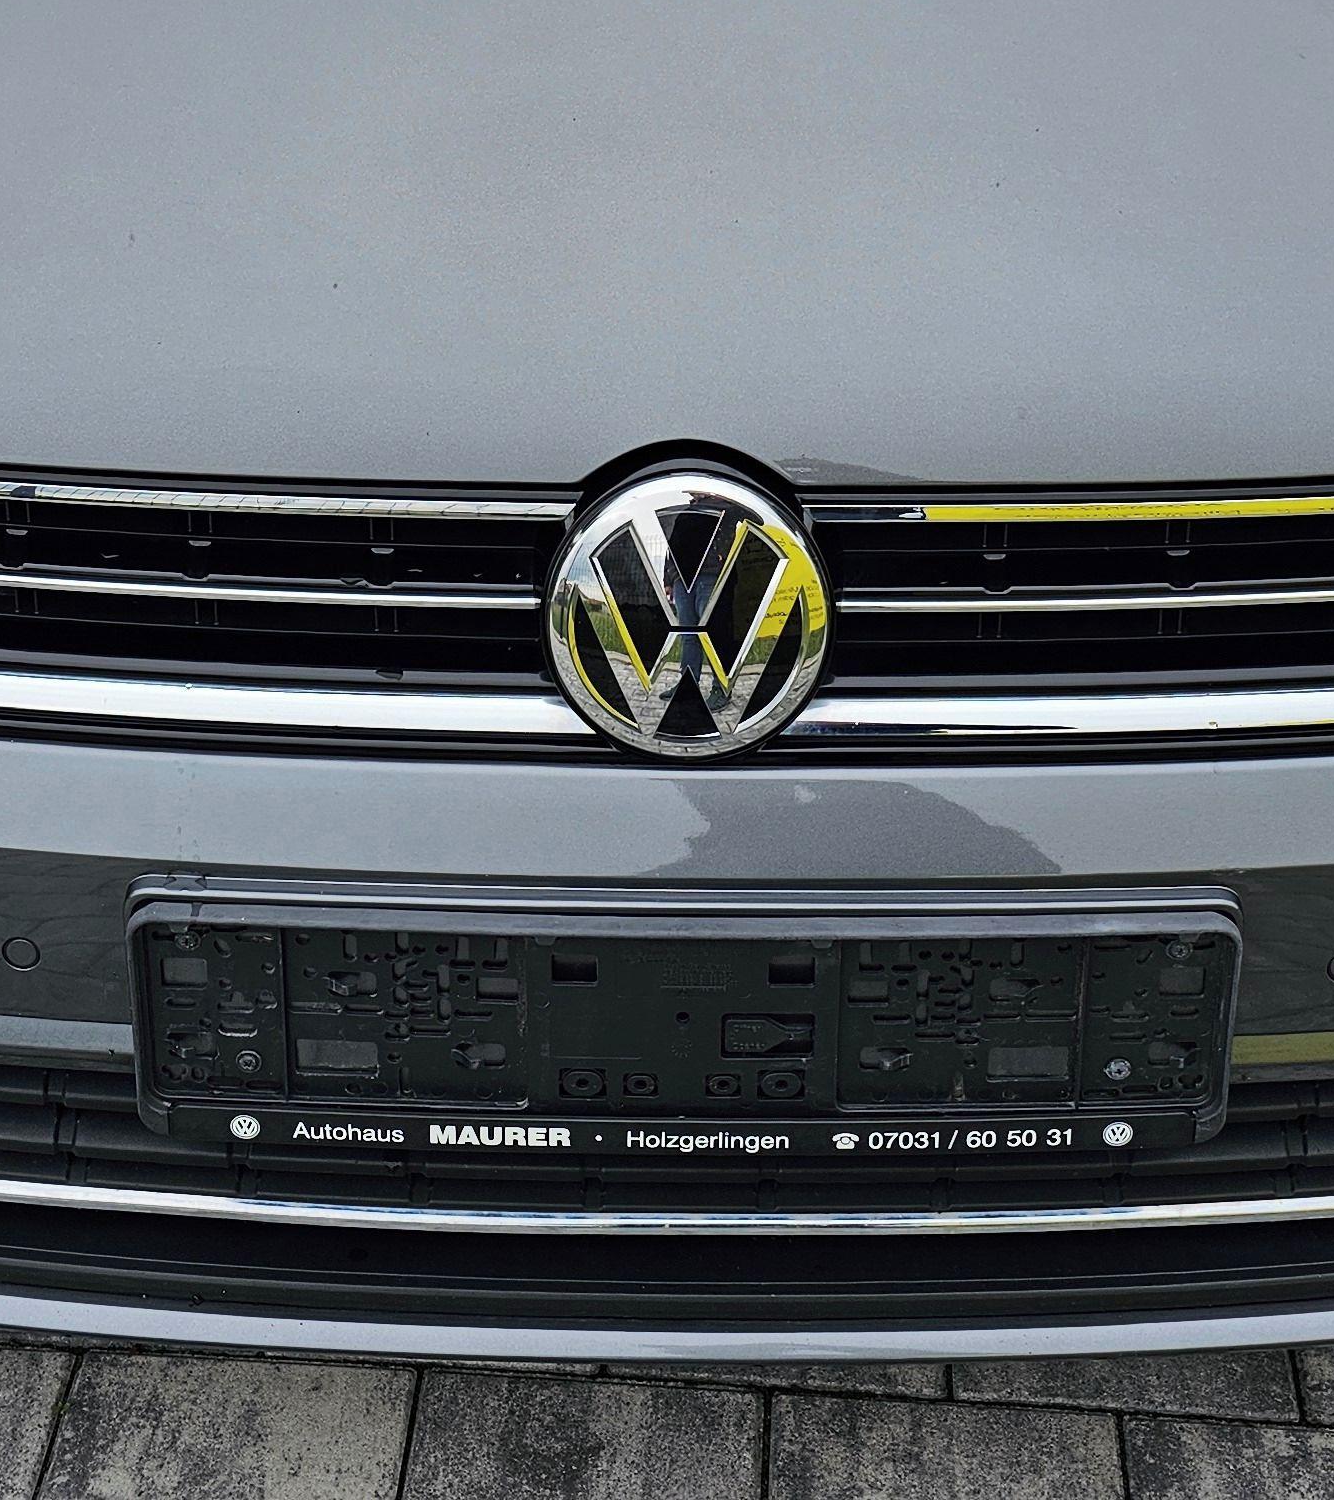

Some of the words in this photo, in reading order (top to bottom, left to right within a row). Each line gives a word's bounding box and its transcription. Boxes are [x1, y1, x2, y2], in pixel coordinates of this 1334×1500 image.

[292, 1121, 405, 1143] Autohaus
[429, 1124, 572, 1147] MAURER
[626, 1130, 790, 1154] Holzgerlingen
[867, 1131, 941, 1150] 07031
[965, 1129, 997, 1149] 60
[1006, 1128, 1037, 1148] 50
[1045, 1127, 1073, 1148] 31
